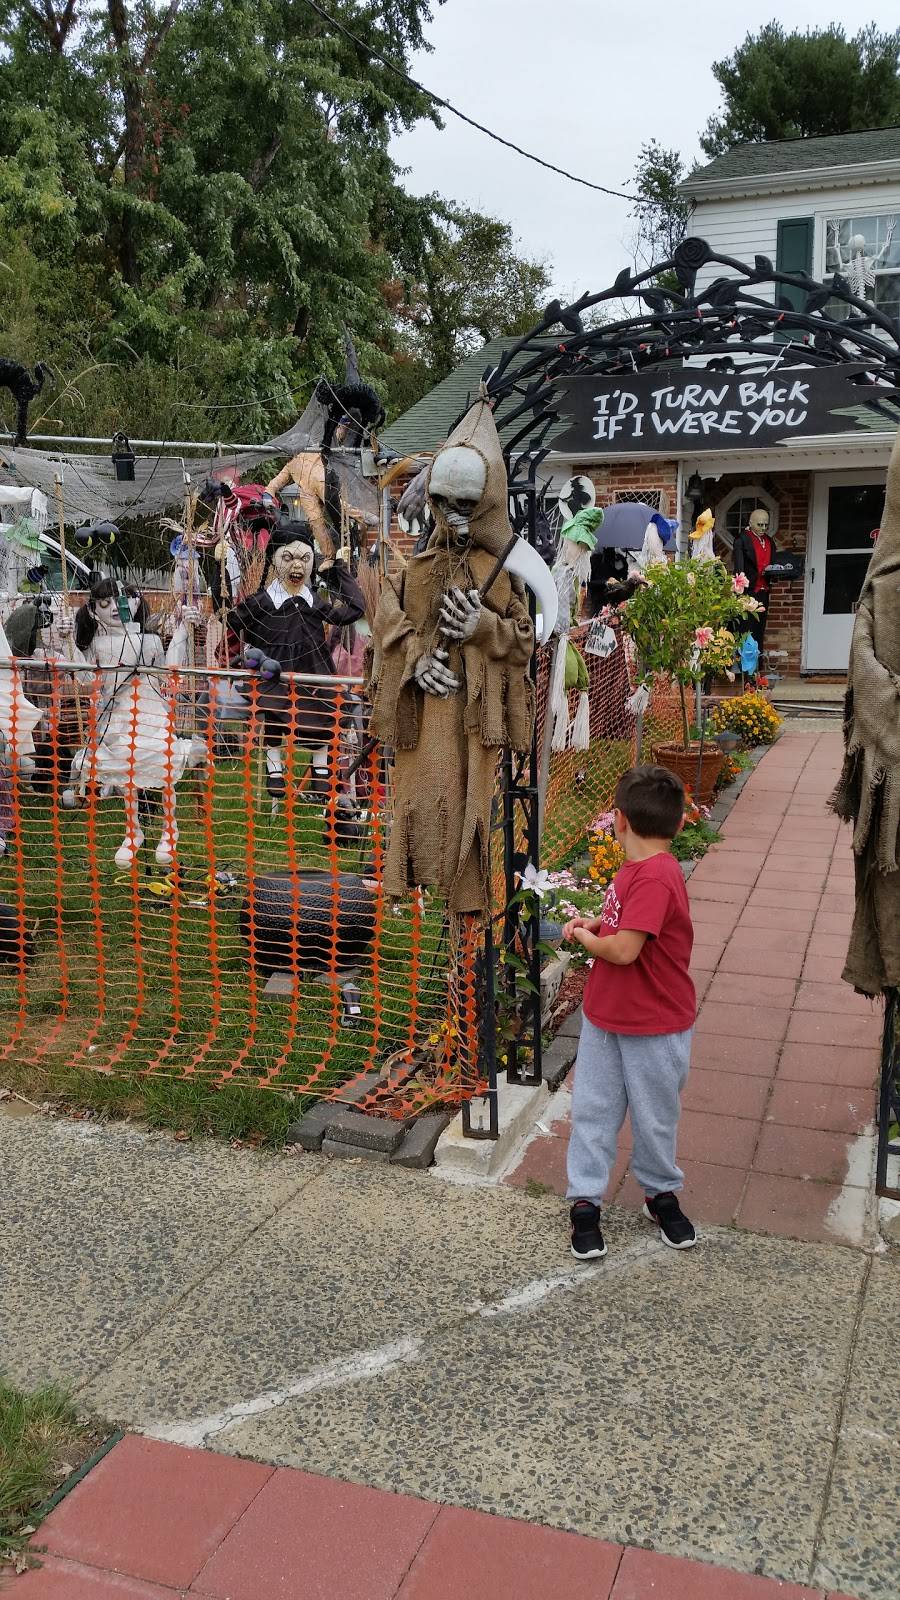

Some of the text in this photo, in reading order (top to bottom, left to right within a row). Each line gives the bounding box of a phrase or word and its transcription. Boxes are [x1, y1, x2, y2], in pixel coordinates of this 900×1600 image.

[592, 380, 810, 415] I'D TURN BACK
[592, 408, 808, 440] IF I WERE YOU
